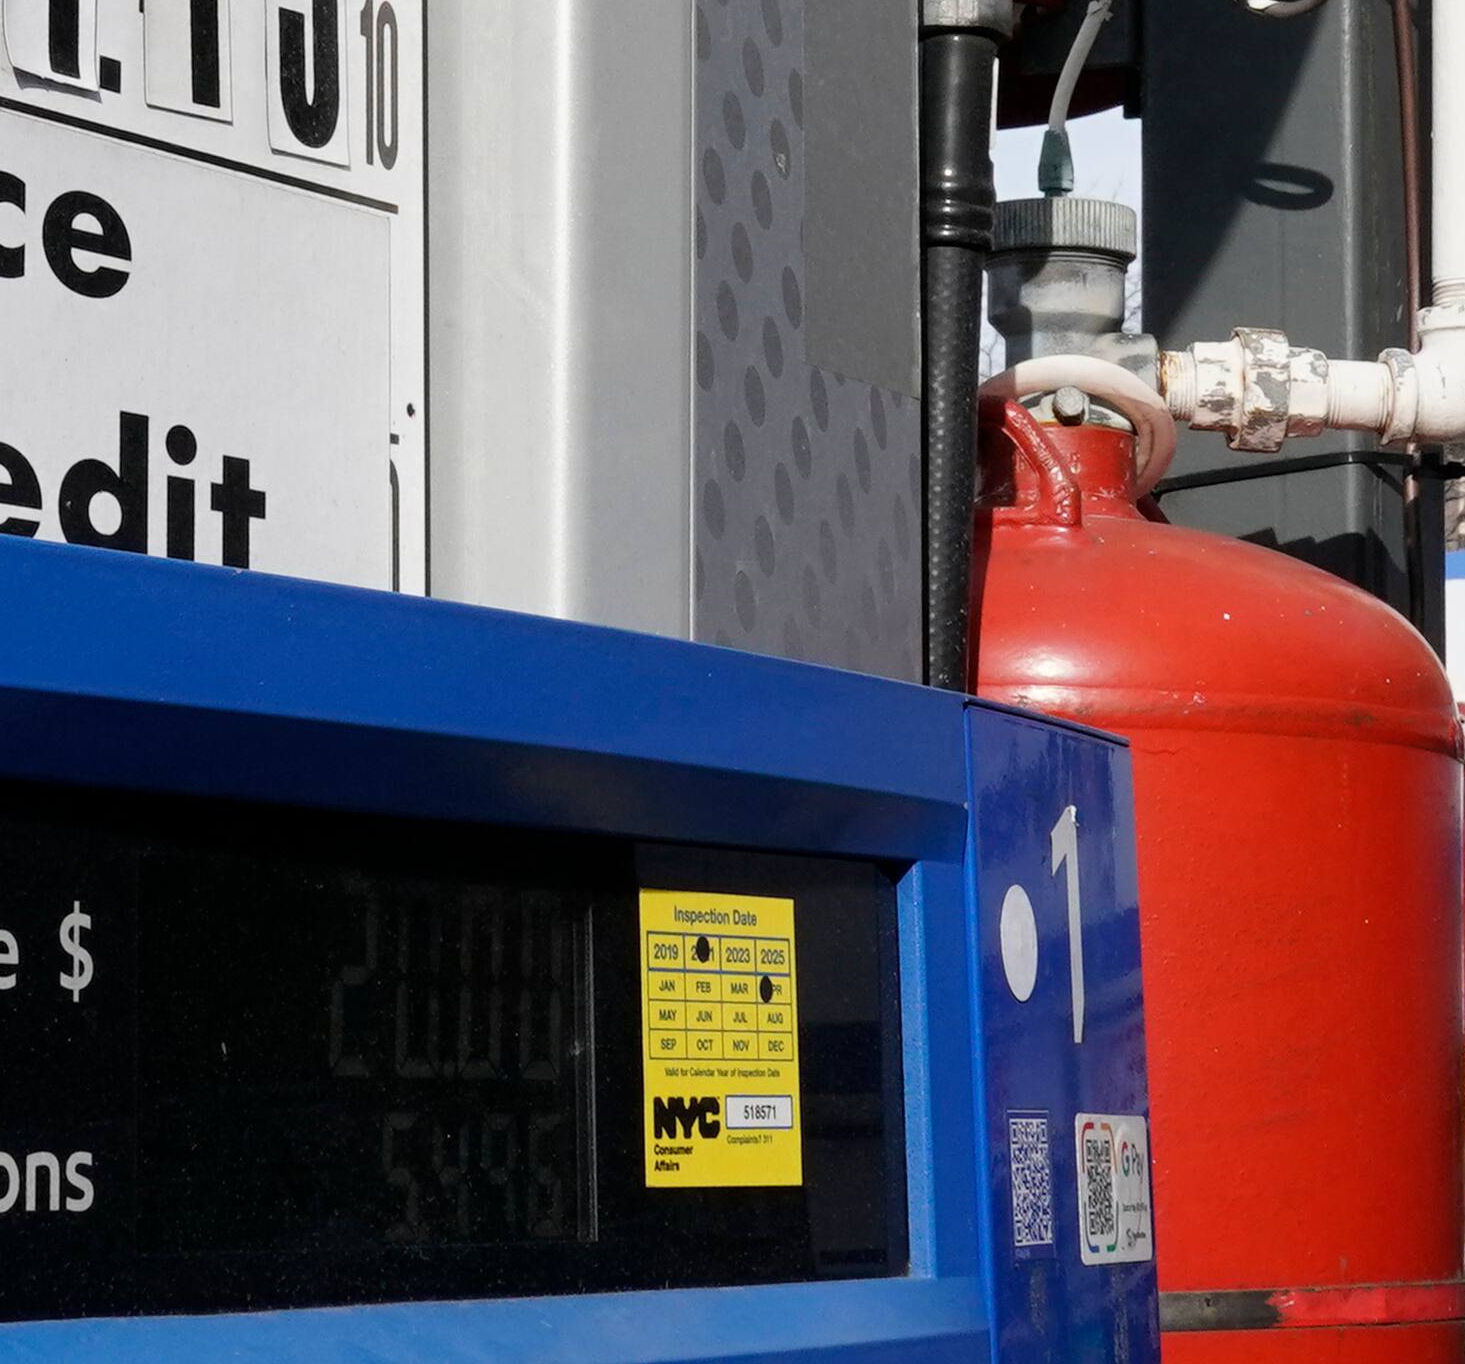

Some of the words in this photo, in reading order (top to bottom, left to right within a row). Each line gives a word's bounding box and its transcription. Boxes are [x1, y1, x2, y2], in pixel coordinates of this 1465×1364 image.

[674, 906, 730, 926] Inspection
[733, 909, 757, 926] Date
[1050, 804, 1087, 1044] 1
[59, 901, 95, 1002] $
[654, 943, 679, 960] 2019
[691, 946, 715, 962] 21
[725, 947, 750, 963] 2023
[760, 949, 785, 964] 2025
[658, 980, 675, 992] JAN
[696, 981, 711, 993] FEB
[730, 983, 749, 994] MAR
[659, 1009, 676, 1021] MAY
[696, 1011, 713, 1022] JUN
[733, 1012, 748, 1023] JUL
[767, 1013, 783, 1024] AUG
[660, 1038, 676, 1050] SEP
[696, 1039, 713, 1051] OCT
[733, 1040, 750, 1051] NOV
[768, 1041, 784, 1052] DEC
[653, 1096, 721, 1139] NYC
[744, 1105, 777, 1120] 518571
[654, 1144, 693, 1155] Consumer
[654, 1160, 680, 1171] Affairs
